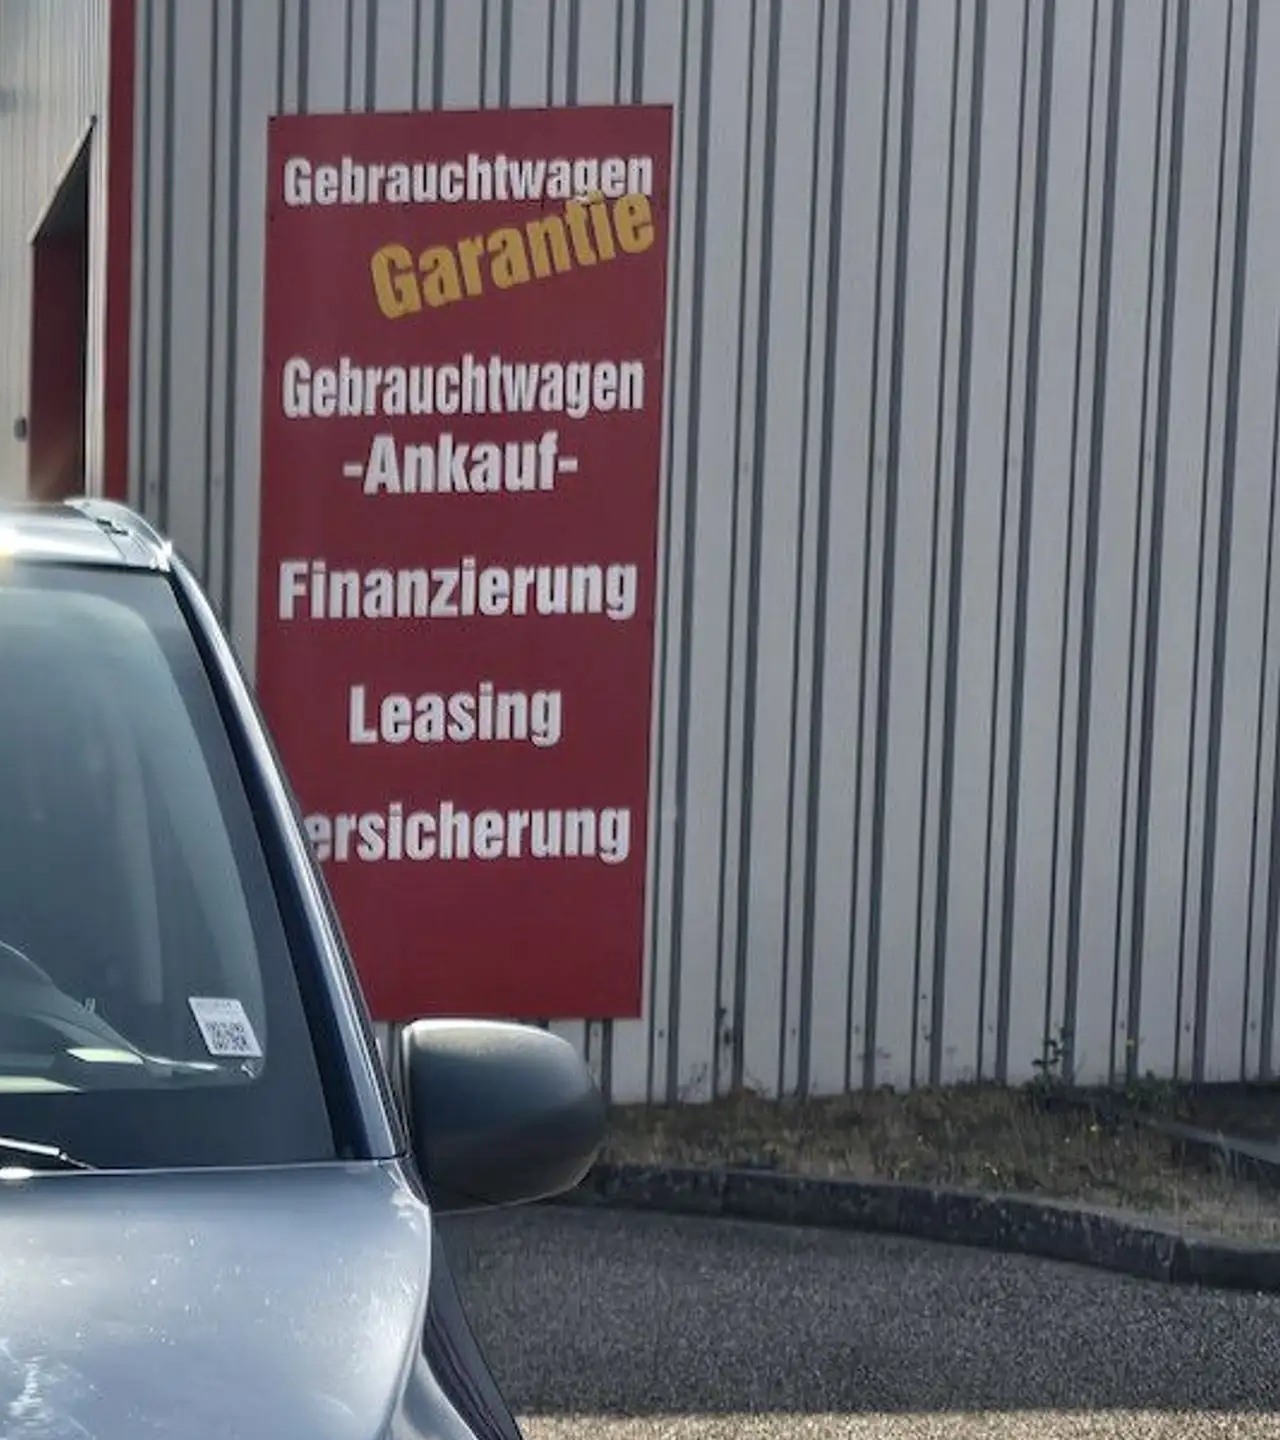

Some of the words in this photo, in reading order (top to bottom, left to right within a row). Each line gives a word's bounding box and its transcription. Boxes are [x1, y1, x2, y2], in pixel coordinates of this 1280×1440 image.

[283, 153, 653, 205] Gebrauchtwagen
[370, 190, 655, 319] Garantie
[282, 353, 644, 418] Gebrauchtwagen
[343, 431, 578, 495] -Ankauf-
[278, 556, 638, 620] Finanzierung
[349, 681, 562, 747] Leasing
[303, 801, 631, 865] ersicherung
